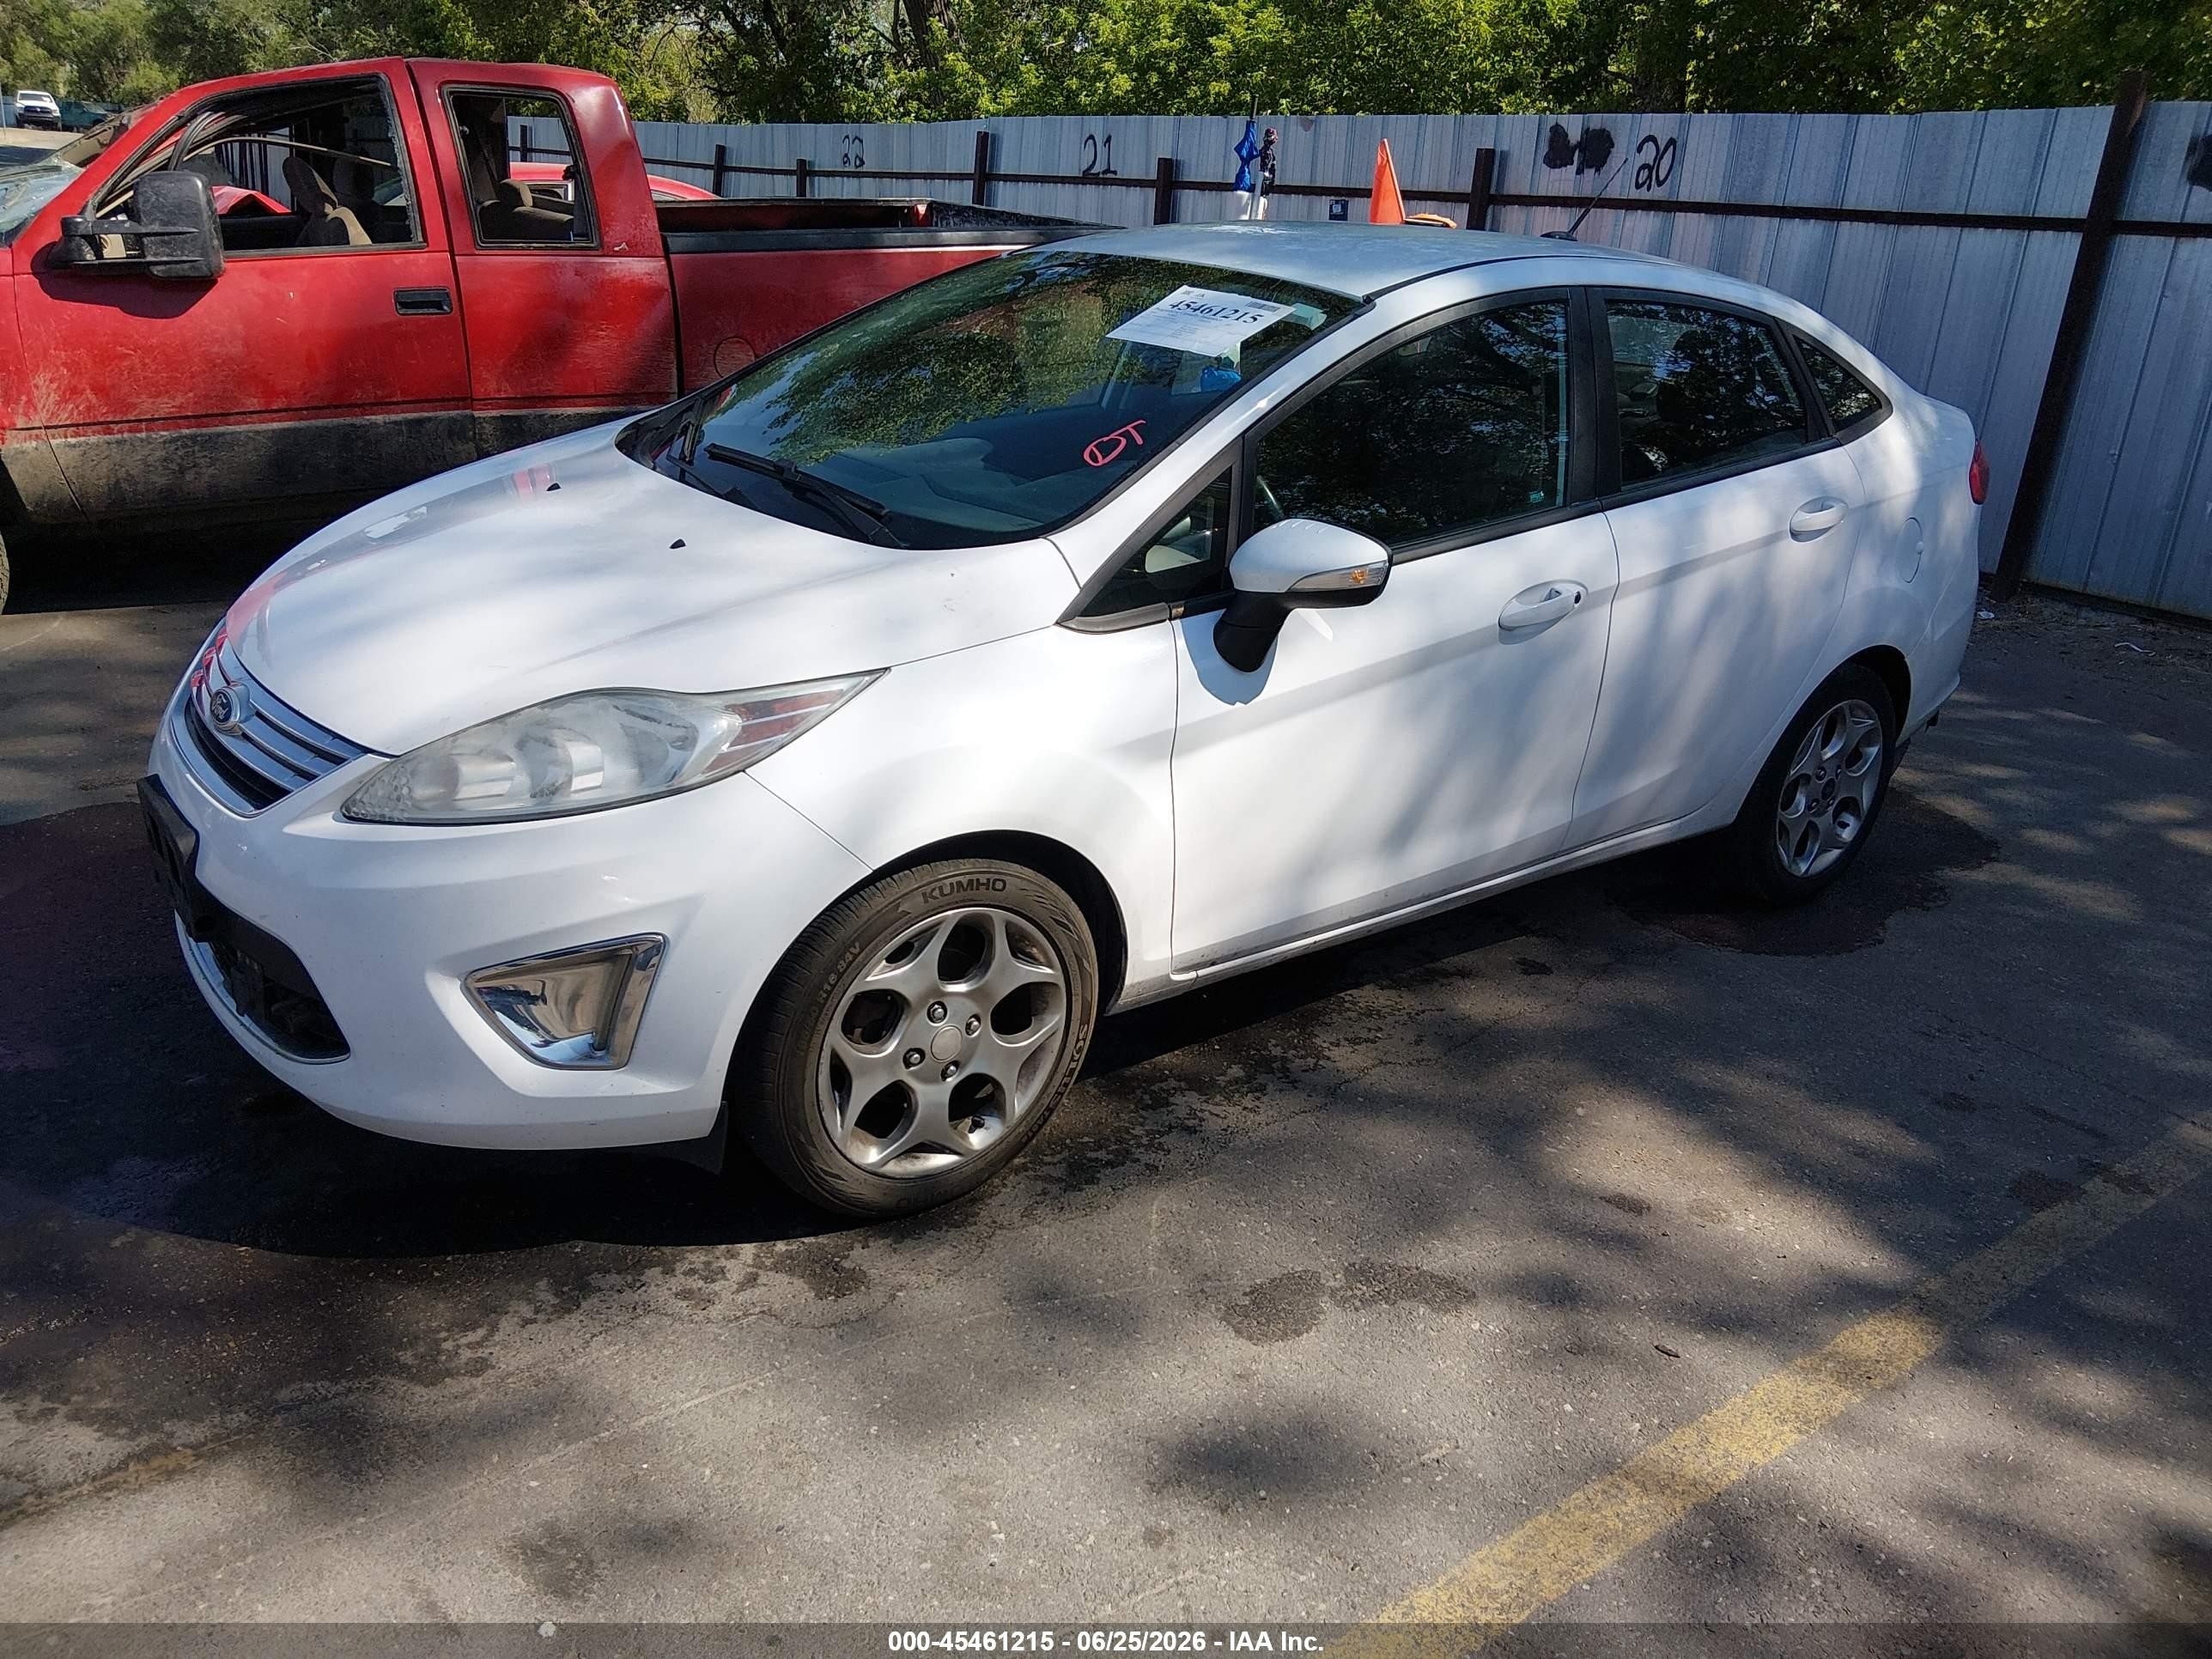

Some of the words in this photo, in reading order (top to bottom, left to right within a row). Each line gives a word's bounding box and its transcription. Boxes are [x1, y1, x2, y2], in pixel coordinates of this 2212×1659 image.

[842, 134, 865, 168] 22
[1083, 134, 1117, 176] 21
[1635, 135, 1676, 192] 20
[1169, 301, 1264, 324] 45461215
[921, 878, 1006, 904] KUMHO
[1049, 1023, 1088, 1109] SOLUS
